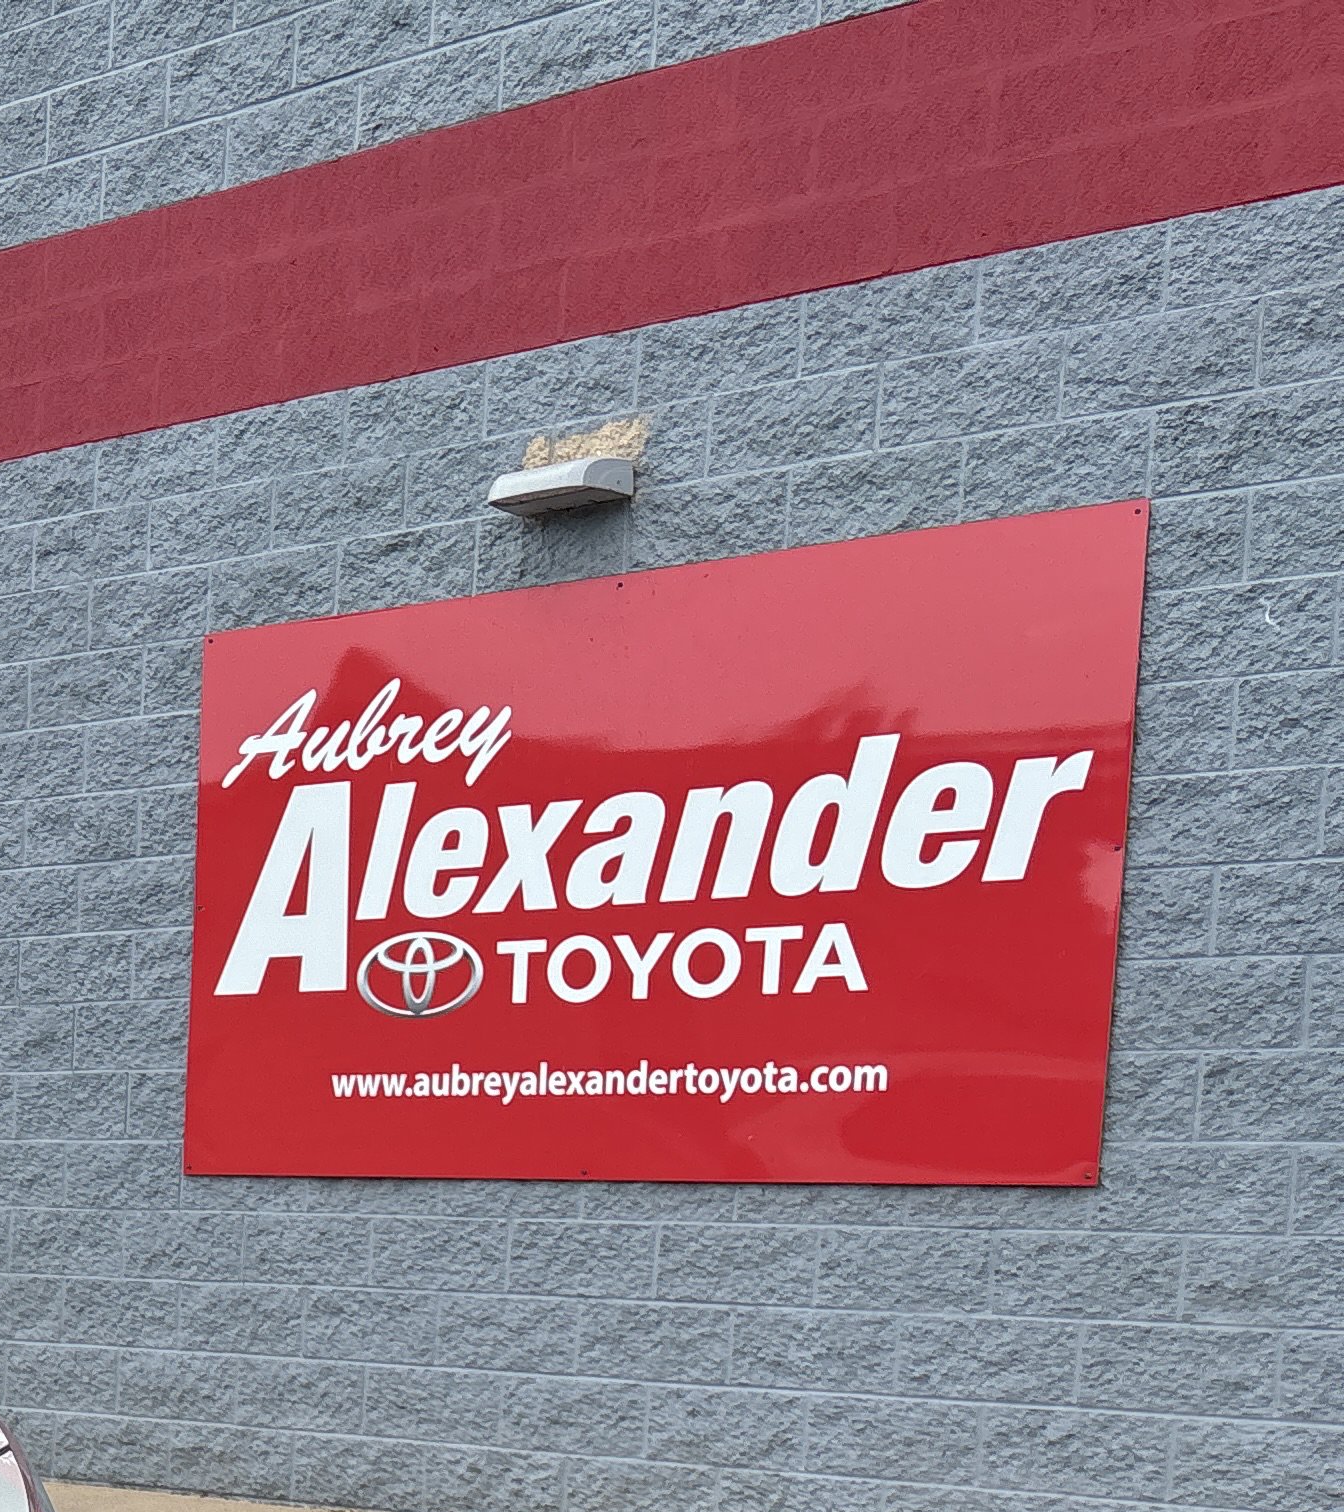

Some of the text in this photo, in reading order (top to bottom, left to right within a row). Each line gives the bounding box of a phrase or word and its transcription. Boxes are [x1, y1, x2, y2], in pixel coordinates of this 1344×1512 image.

[221, 677, 512, 789] Aubrey
[214, 733, 1094, 996] Alexander
[496, 922, 869, 1004] TOYOTA
[331, 1059, 888, 1105] www.aubreyalexandertoyota.com
